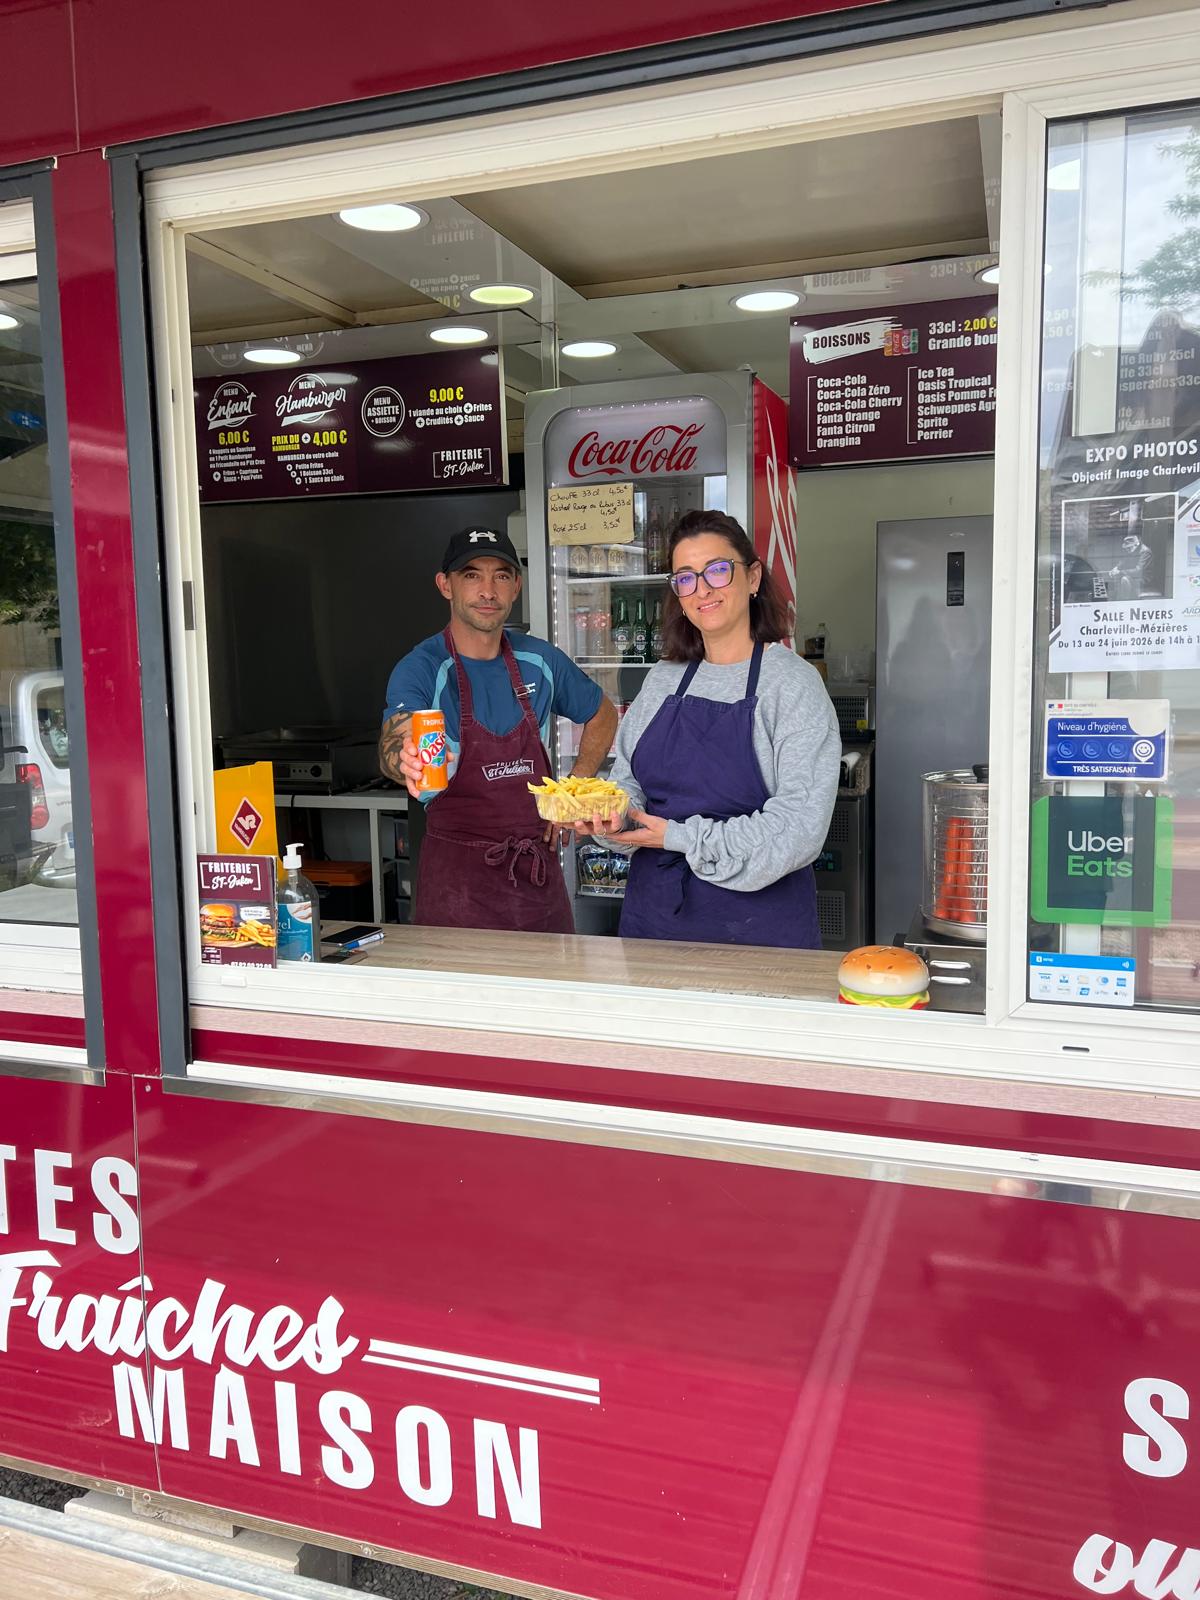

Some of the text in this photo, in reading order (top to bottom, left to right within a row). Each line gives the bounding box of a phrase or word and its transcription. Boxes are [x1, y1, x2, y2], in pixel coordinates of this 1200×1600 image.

[928, 320, 955, 335] 33cl
[964, 318, 987, 332] 2,00
[989, 317, 996, 328] €
[812, 332, 871, 349] BOISSONS
[928, 335, 972, 351] Grande
[918, 367, 954, 379] Ice Tea
[299, 381, 315, 389] MENU
[817, 375, 866, 389] Coca-Cola
[918, 375, 991, 392] Oasis Tropical
[1120, 378, 1177, 392] sperados
[429, 386, 464, 404] 9,00 €
[817, 384, 890, 400] Coca-Cola Zéro
[918, 392, 946, 404] Oasis
[948, 390, 986, 401] Pomme
[207, 392, 256, 421] Enfant
[275, 388, 346, 416] Hamburger
[374, 397, 390, 406] MENU
[817, 396, 902, 412] Coca-Cola Cherry
[367, 405, 399, 417] ASSIETTE
[412, 408, 434, 417] viande
[444, 405, 462, 414] choix
[473, 403, 493, 412] Frites
[918, 402, 976, 416] Schweppes
[426, 414, 485, 426] Crudités Sauce
[817, 410, 880, 424] Fanta Orange
[918, 417, 948, 429] Sprite
[817, 423, 875, 436] Fanta Citron
[918, 429, 953, 441] Perrier
[219, 430, 249, 446] 6,00 €
[271, 434, 299, 445] PRIX DU
[313, 430, 347, 446] 4,00 €
[817, 436, 861, 448] Orangina
[440, 448, 483, 461] FRITERIE
[568, 423, 705, 478] Coca-Cola
[1086, 439, 1198, 463] EXPO PHOTOS
[1071, 469, 1112, 484] Objectif
[1116, 468, 1149, 479] Image
[1080, 623, 1188, 636] Charleville-Mézières
[1072, 640, 1082, 648] 13
[1111, 638, 1128, 648] juin
[1130, 637, 1152, 646] 2026
[1155, 636, 1165, 645] de
[1169, 635, 1184, 644] 14h
[1187, 636, 1192, 644] à
[1057, 721, 1127, 733] Niveau d'hygiène
[1073, 764, 1137, 774] TRÈS SATISFAISANT
[1068, 830, 1133, 853] Uber
[208, 862, 251, 874] FRITERIE
[1067, 855, 1133, 878] Eats
[0, 1250, 359, 1375] Fraîches
[1123, 1377, 1189, 1477] S
[112, 1361, 542, 1529] MAISON
